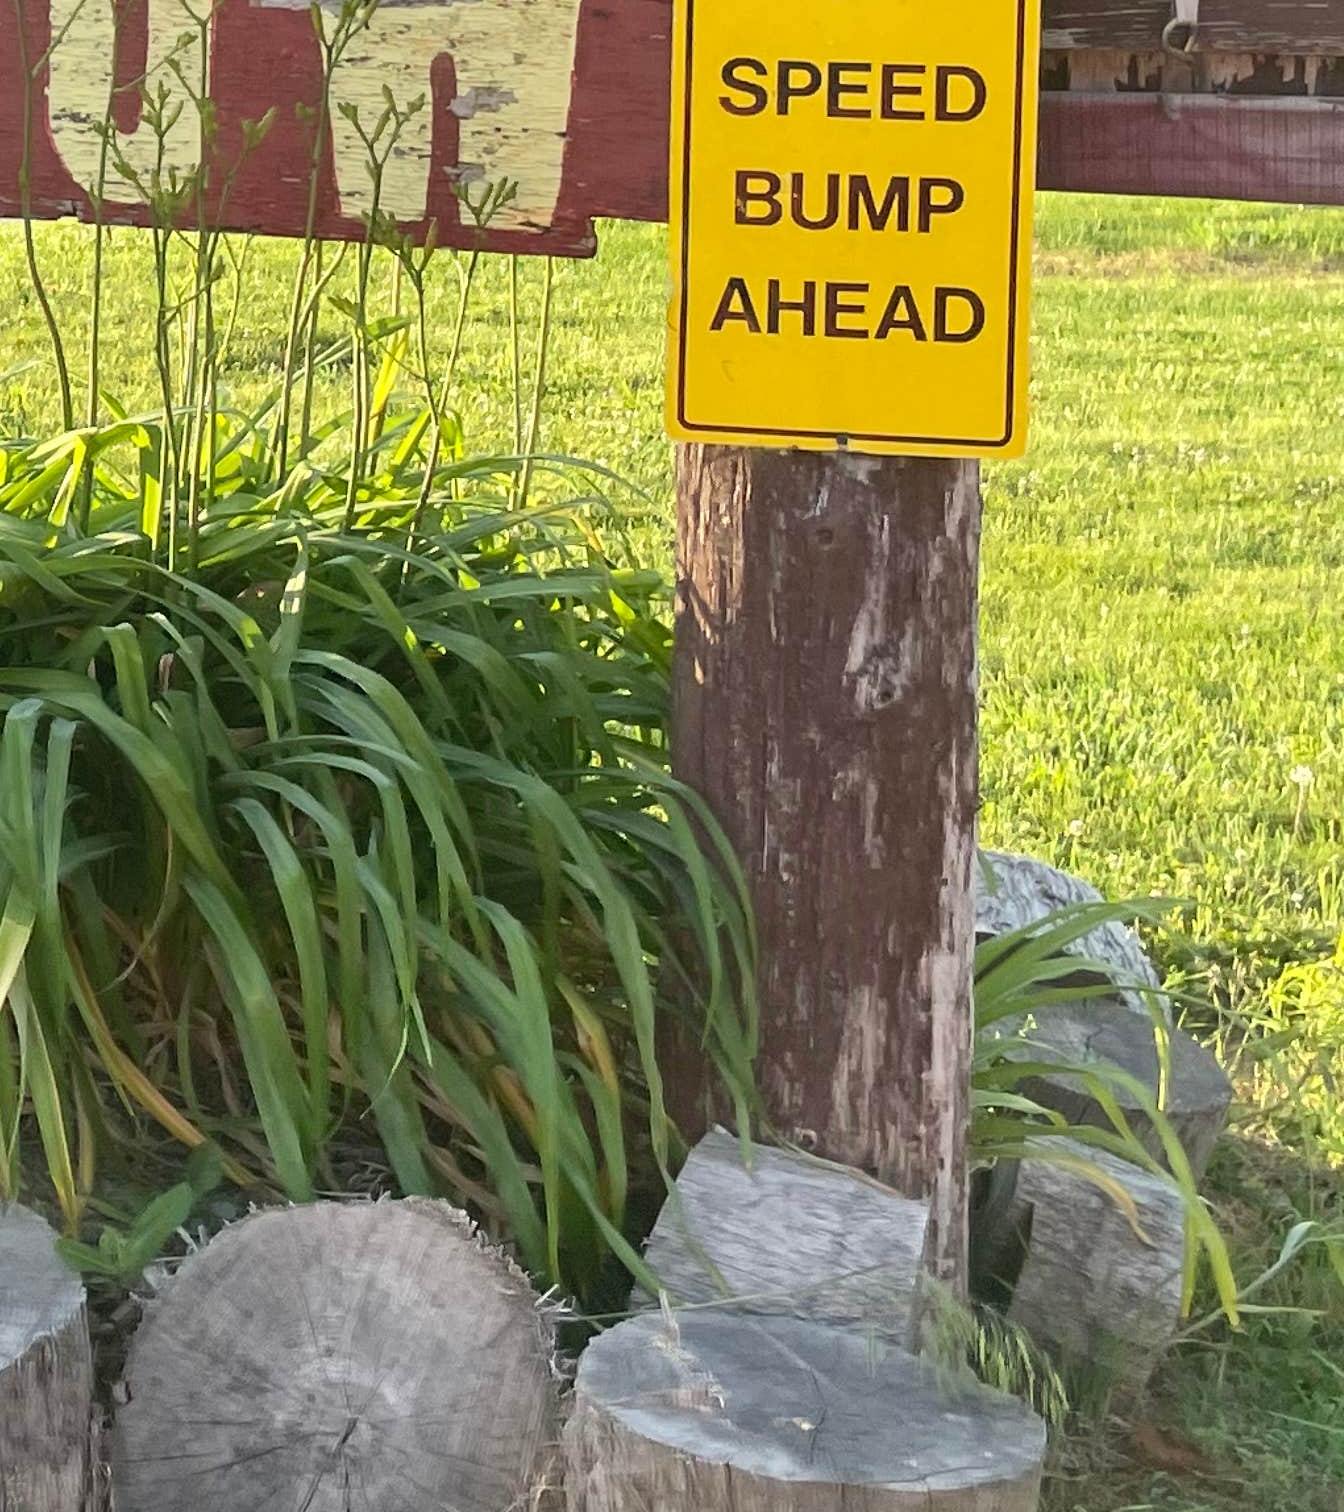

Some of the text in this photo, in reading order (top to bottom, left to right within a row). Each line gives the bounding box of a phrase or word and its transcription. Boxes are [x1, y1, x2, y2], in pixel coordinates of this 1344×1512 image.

[718, 57, 987, 122] SPEED
[734, 169, 965, 233] BUMP
[710, 277, 986, 343] AHEAD
